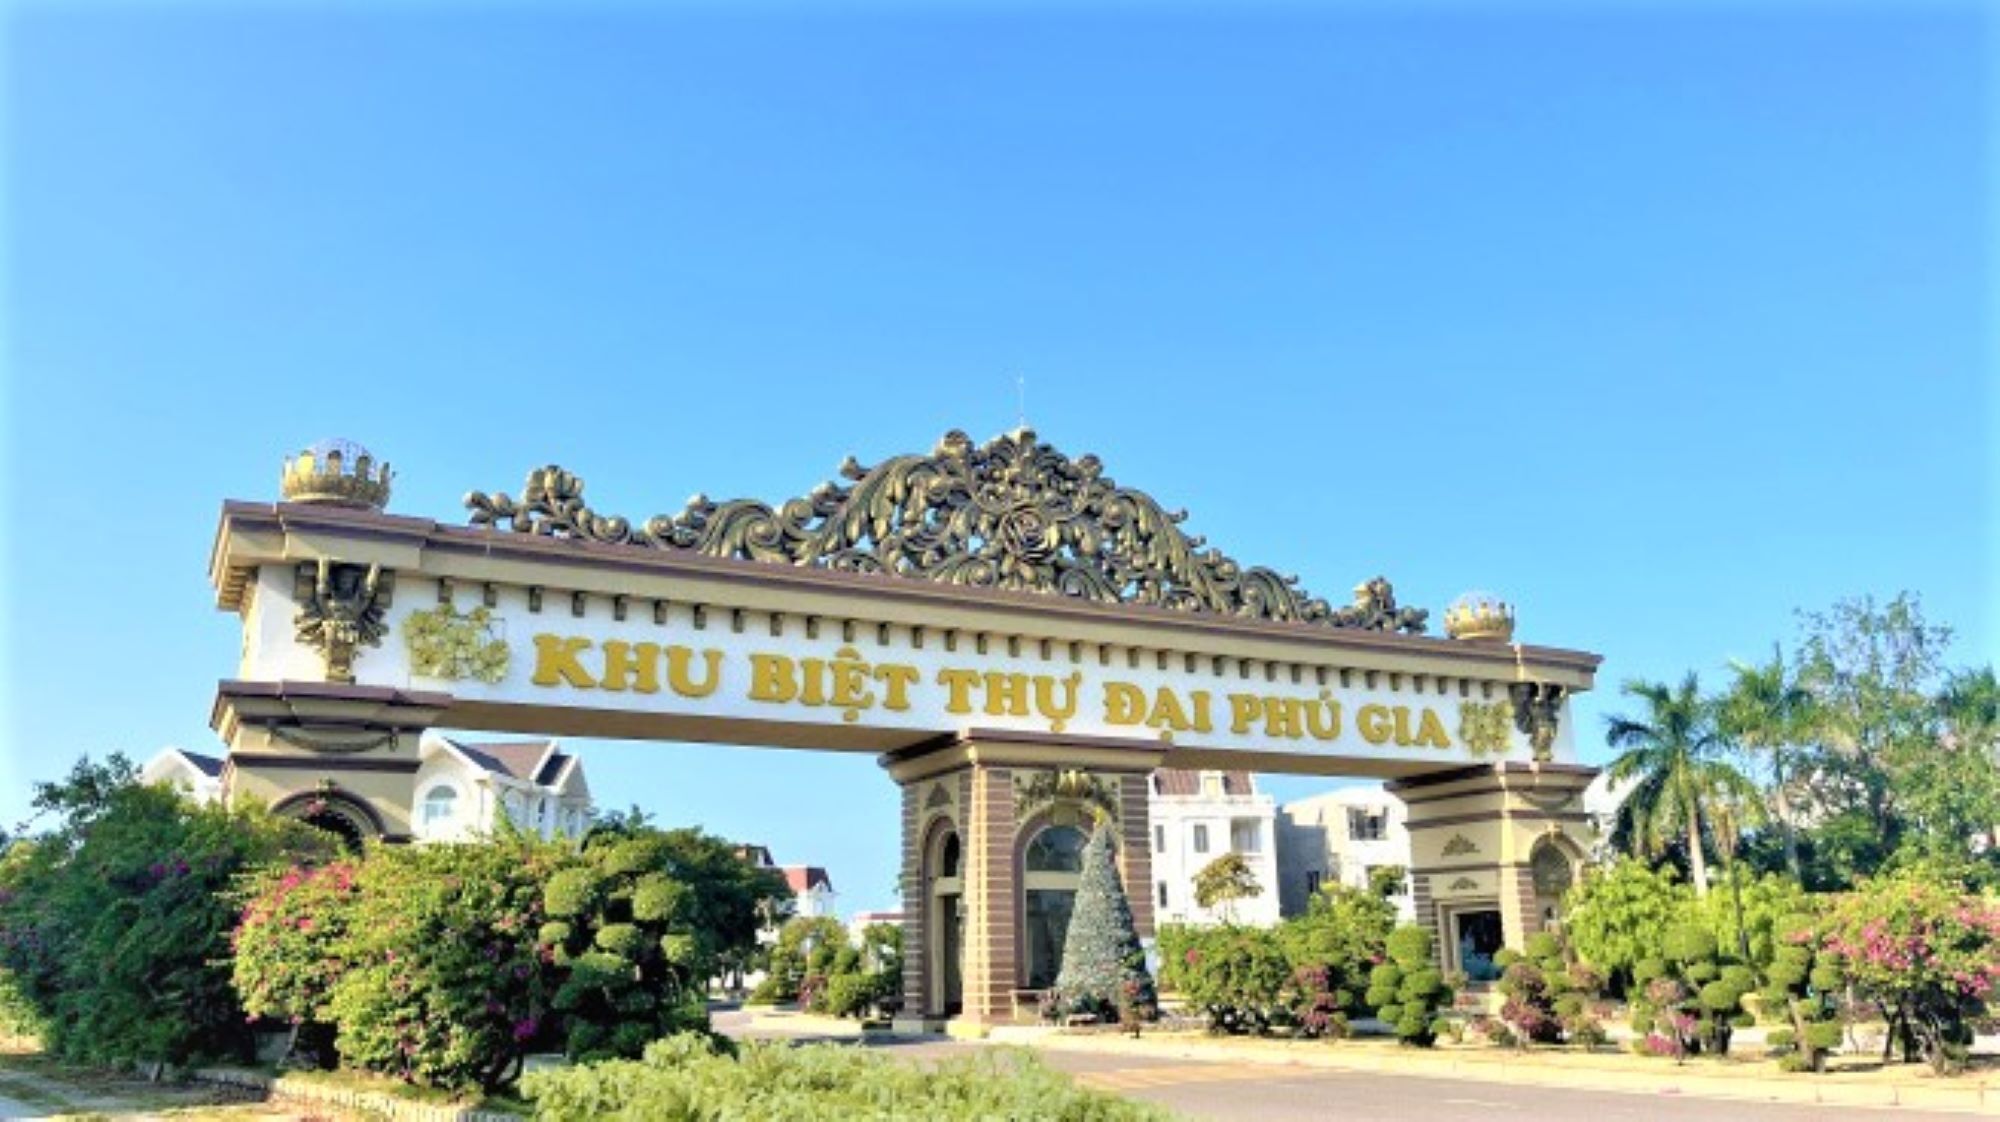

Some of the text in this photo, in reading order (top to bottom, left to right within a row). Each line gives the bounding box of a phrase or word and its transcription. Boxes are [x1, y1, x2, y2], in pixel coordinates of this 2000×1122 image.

[532, 633, 724, 698] KHU
[748, 646, 919, 722] BIỆT
[936, 668, 1081, 732] THỰ
[1102, 681, 1213, 743] ĐẠI
[1356, 703, 1451, 749] GIA
